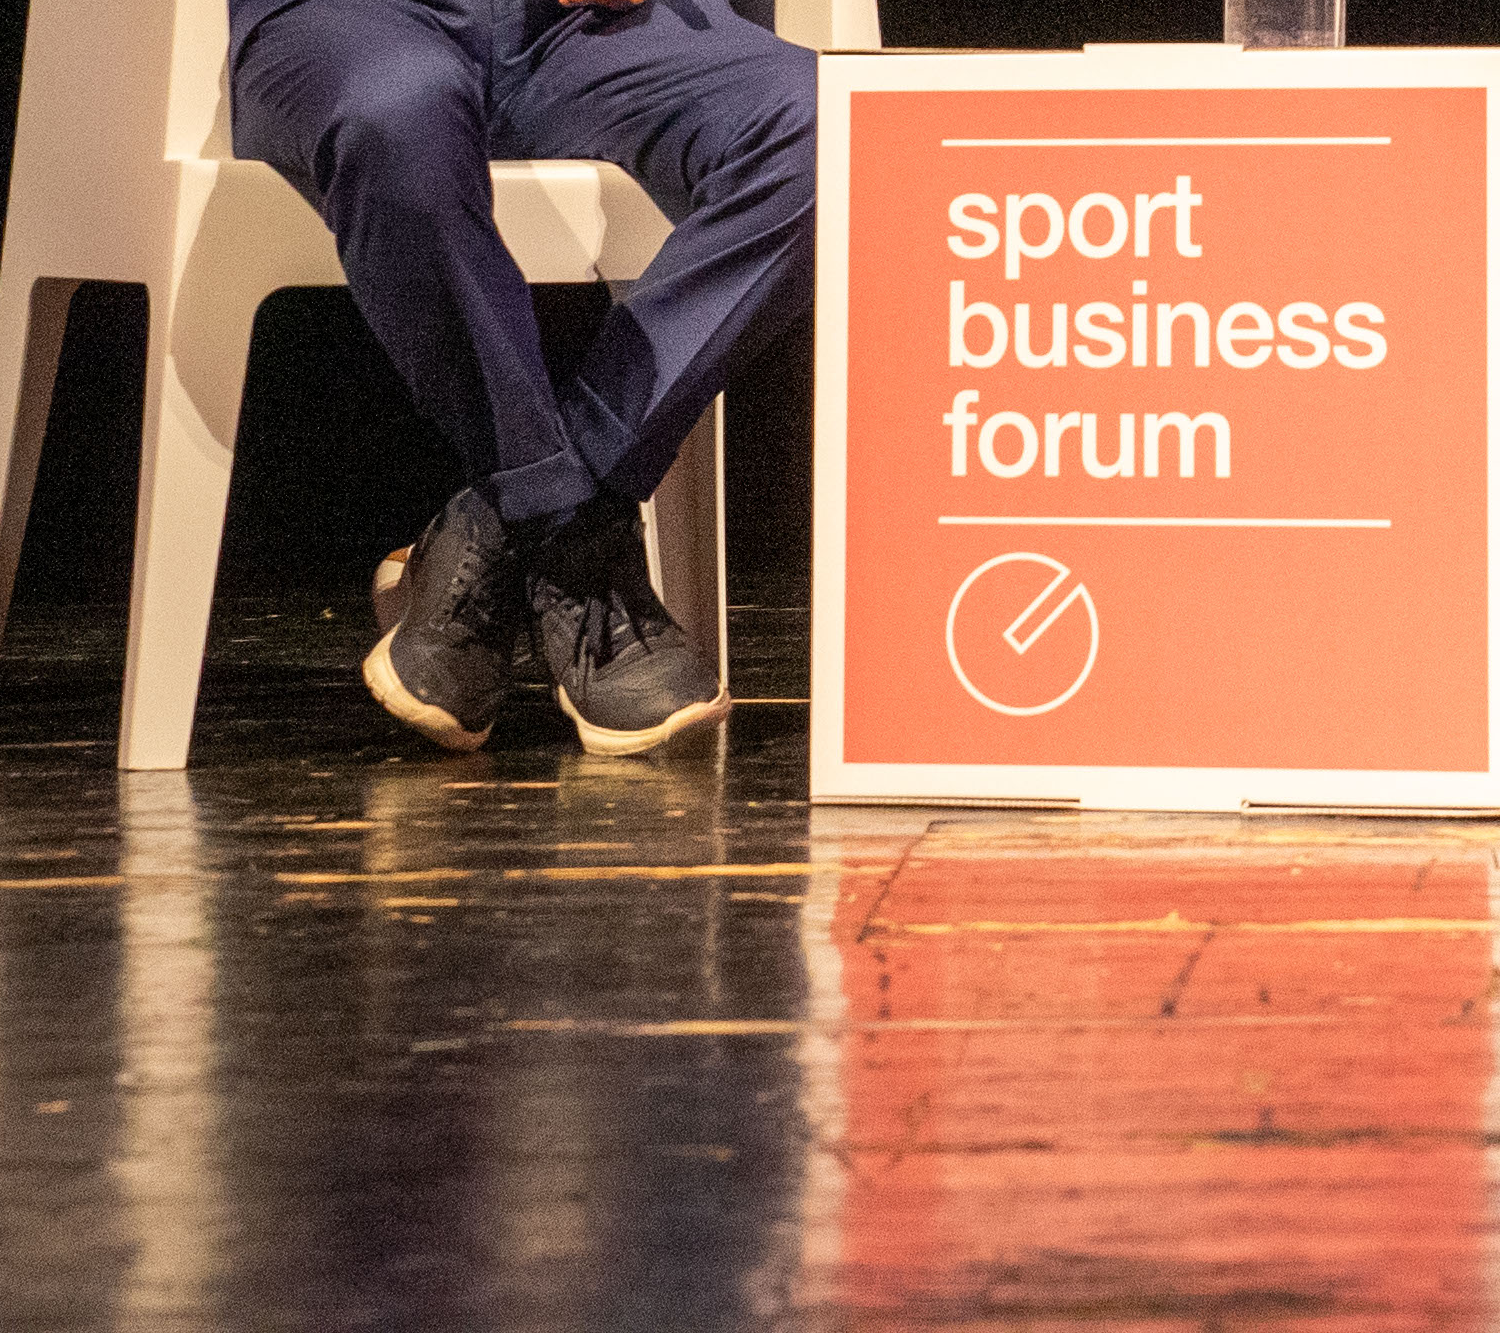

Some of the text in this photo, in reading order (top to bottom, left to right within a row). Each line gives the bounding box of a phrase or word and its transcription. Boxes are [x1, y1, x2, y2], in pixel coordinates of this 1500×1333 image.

[947, 175, 1203, 279] sport
[949, 280, 1388, 370] business
[943, 389, 1231, 479] forum
